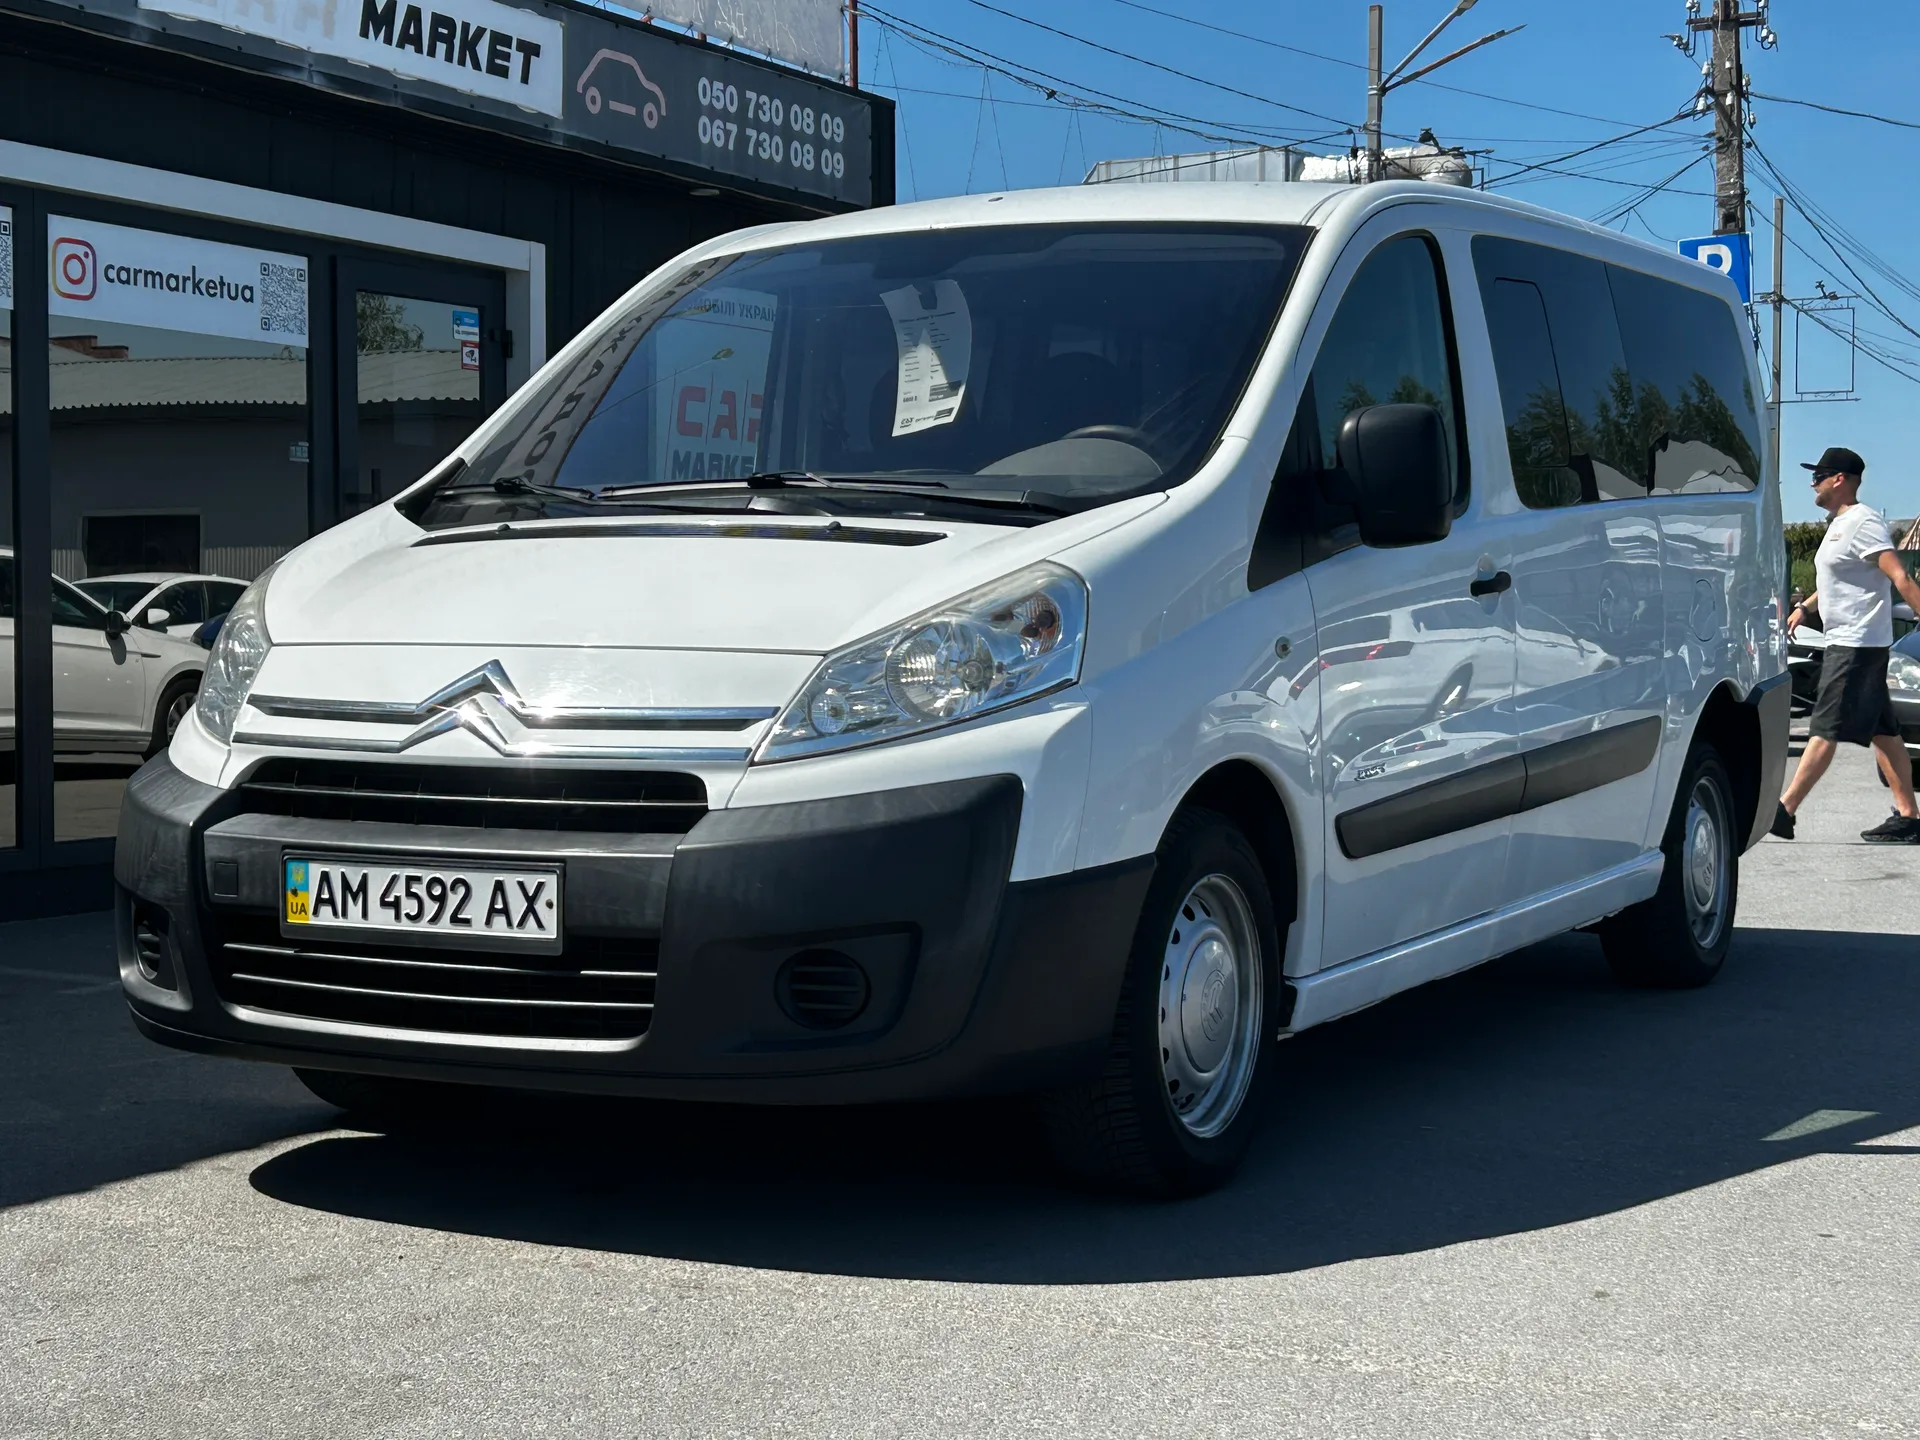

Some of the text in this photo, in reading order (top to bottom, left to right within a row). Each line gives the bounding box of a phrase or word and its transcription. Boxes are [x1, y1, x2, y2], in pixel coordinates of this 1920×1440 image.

[359, 0, 541, 85] MARKET
[698, 77, 844, 143] 050 730 08 09
[698, 115, 844, 179] 067 730 08 09
[103, 263, 255, 304] carmarketua
[290, 903, 307, 916] UA
[312, 868, 546, 930] AM 4592 AX
